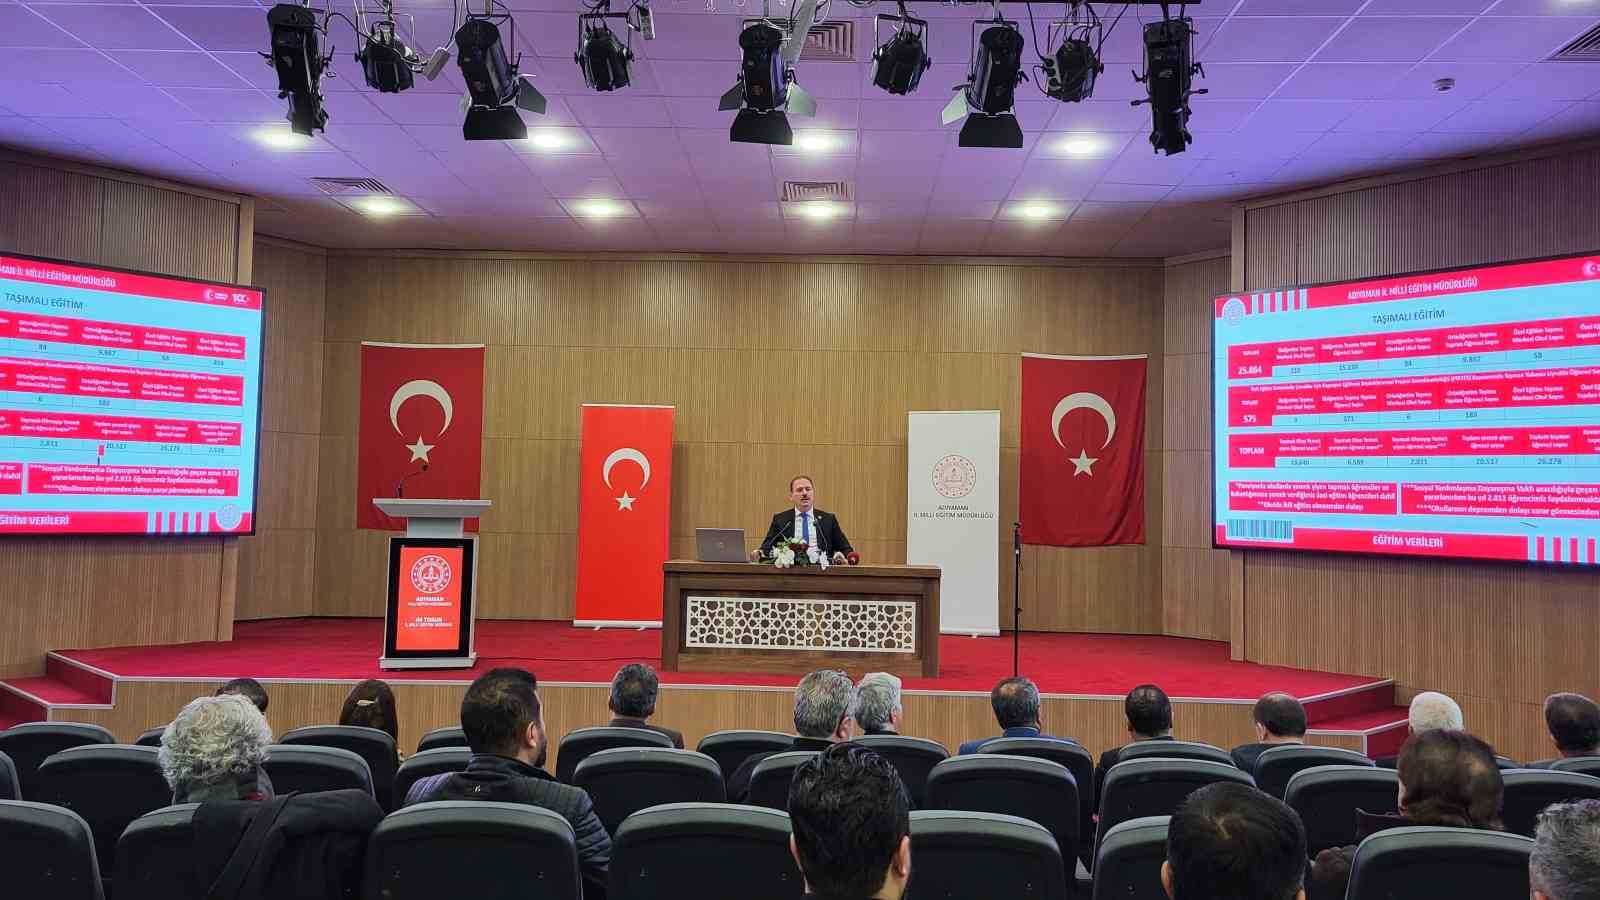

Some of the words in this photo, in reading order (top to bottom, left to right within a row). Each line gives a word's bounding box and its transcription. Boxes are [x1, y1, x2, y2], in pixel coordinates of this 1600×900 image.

[1408, 282, 1432, 294] EĞİTİM
[1433, 276, 1478, 290] MÜDÜRLÜĞÜ
[5, 292, 48, 306] TAŞIMALI
[50, 297, 84, 310] EĞİTİM
[1373, 312, 1412, 324] TAŞIMALI
[1414, 308, 1445, 320] EĞİTİM
[1372, 534, 1403, 546] EĞİTİM
[1405, 536, 1443, 548] VERİLERİ
